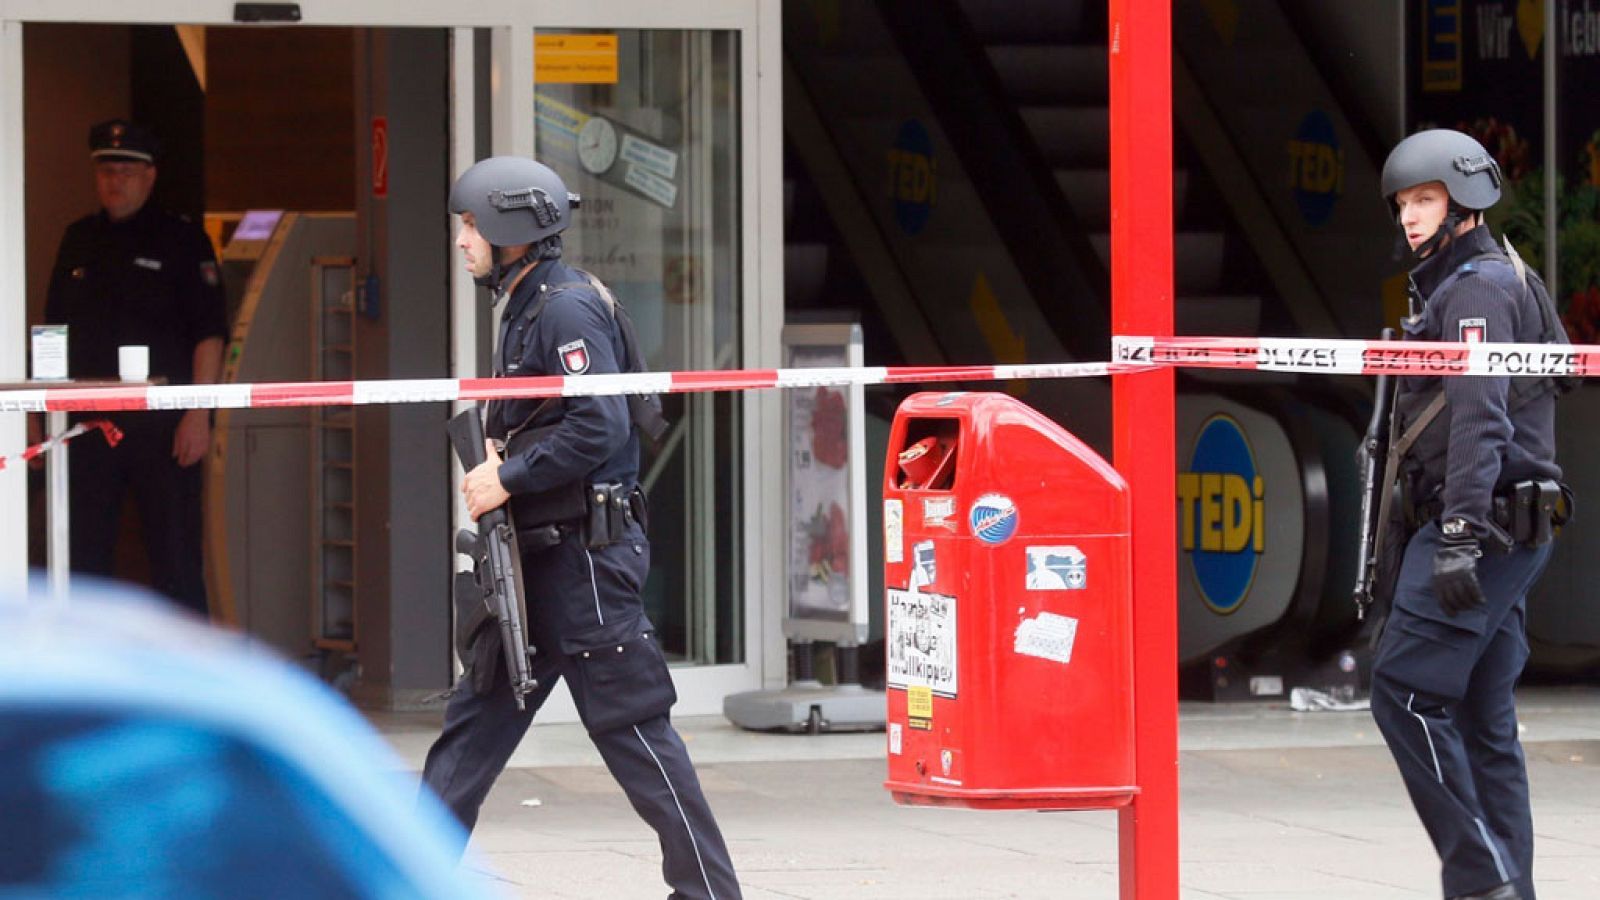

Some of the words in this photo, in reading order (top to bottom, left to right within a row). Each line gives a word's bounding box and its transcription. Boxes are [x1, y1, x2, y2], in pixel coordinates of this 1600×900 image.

[1475, 3, 1513, 59] Wir
[1562, 0, 1600, 56] Leb
[886, 149, 937, 208] TEDi
[1287, 139, 1344, 193] TEDi
[1488, 351, 1588, 375] POLIZEI
[1177, 473, 1264, 555] TEDi
